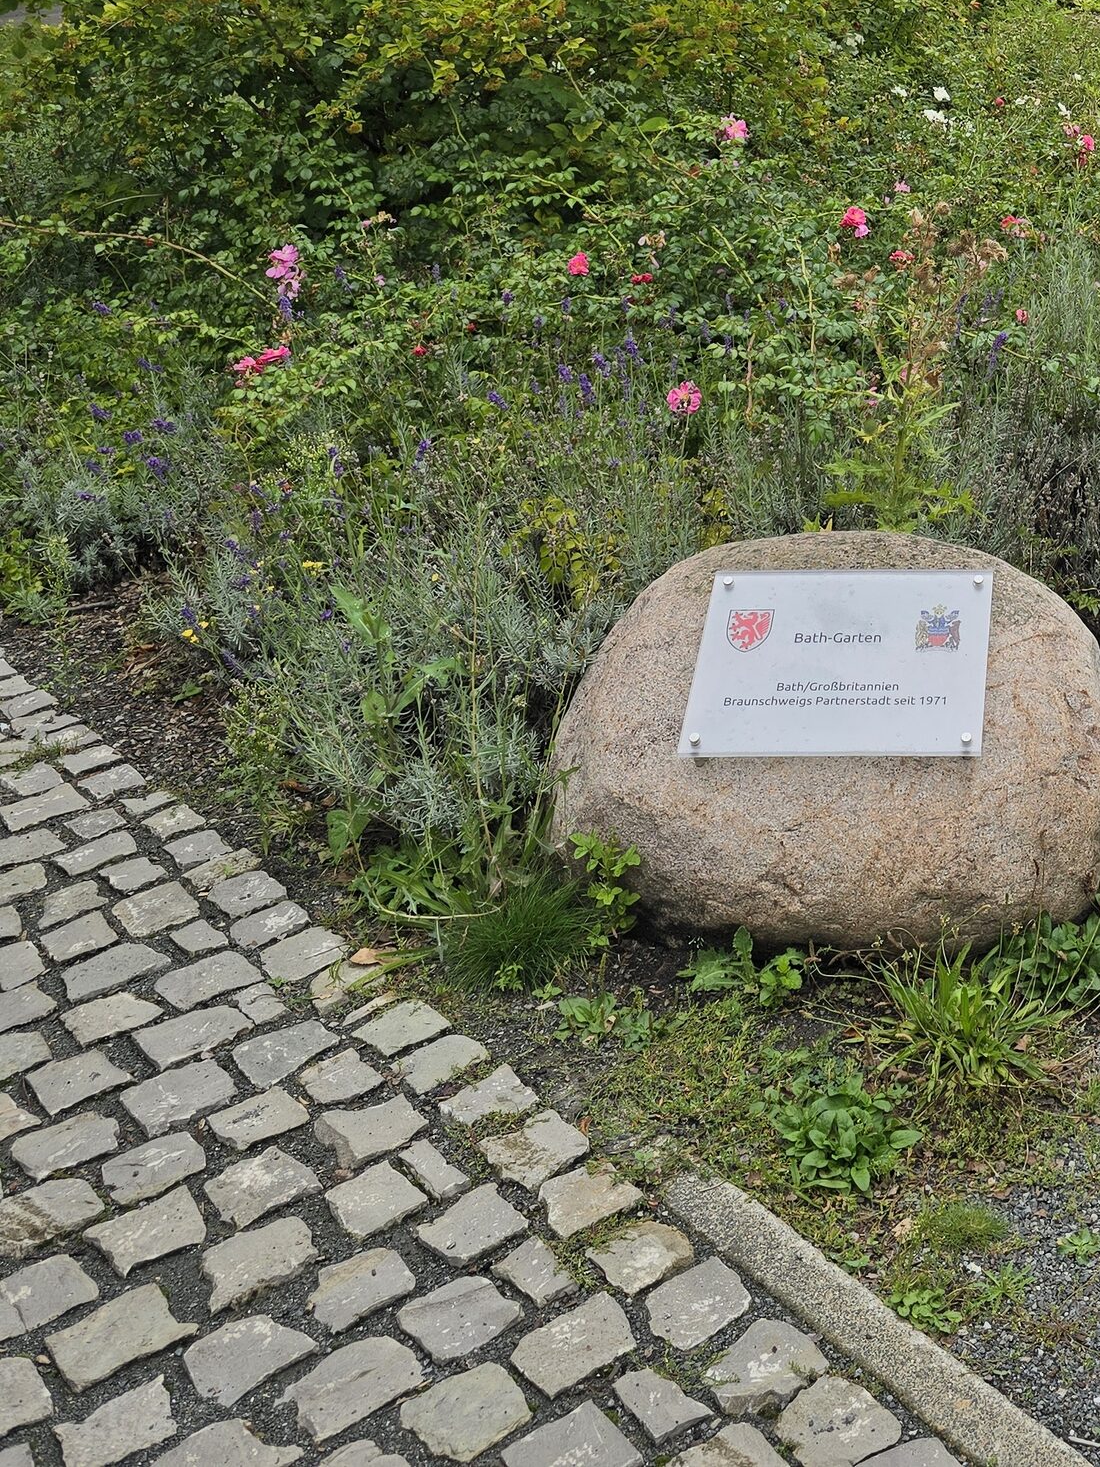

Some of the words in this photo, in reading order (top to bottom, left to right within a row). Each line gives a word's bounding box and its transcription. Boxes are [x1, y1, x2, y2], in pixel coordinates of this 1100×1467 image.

[794, 631, 882, 644] Bath-Garten
[776, 681, 899, 693] Bath/Großbritannien
[723, 696, 812, 708] Braunschweigs
[815, 695, 891, 706] Partnerstadt
[893, 695, 916, 706] seit
[919, 695, 947, 706] 1971
